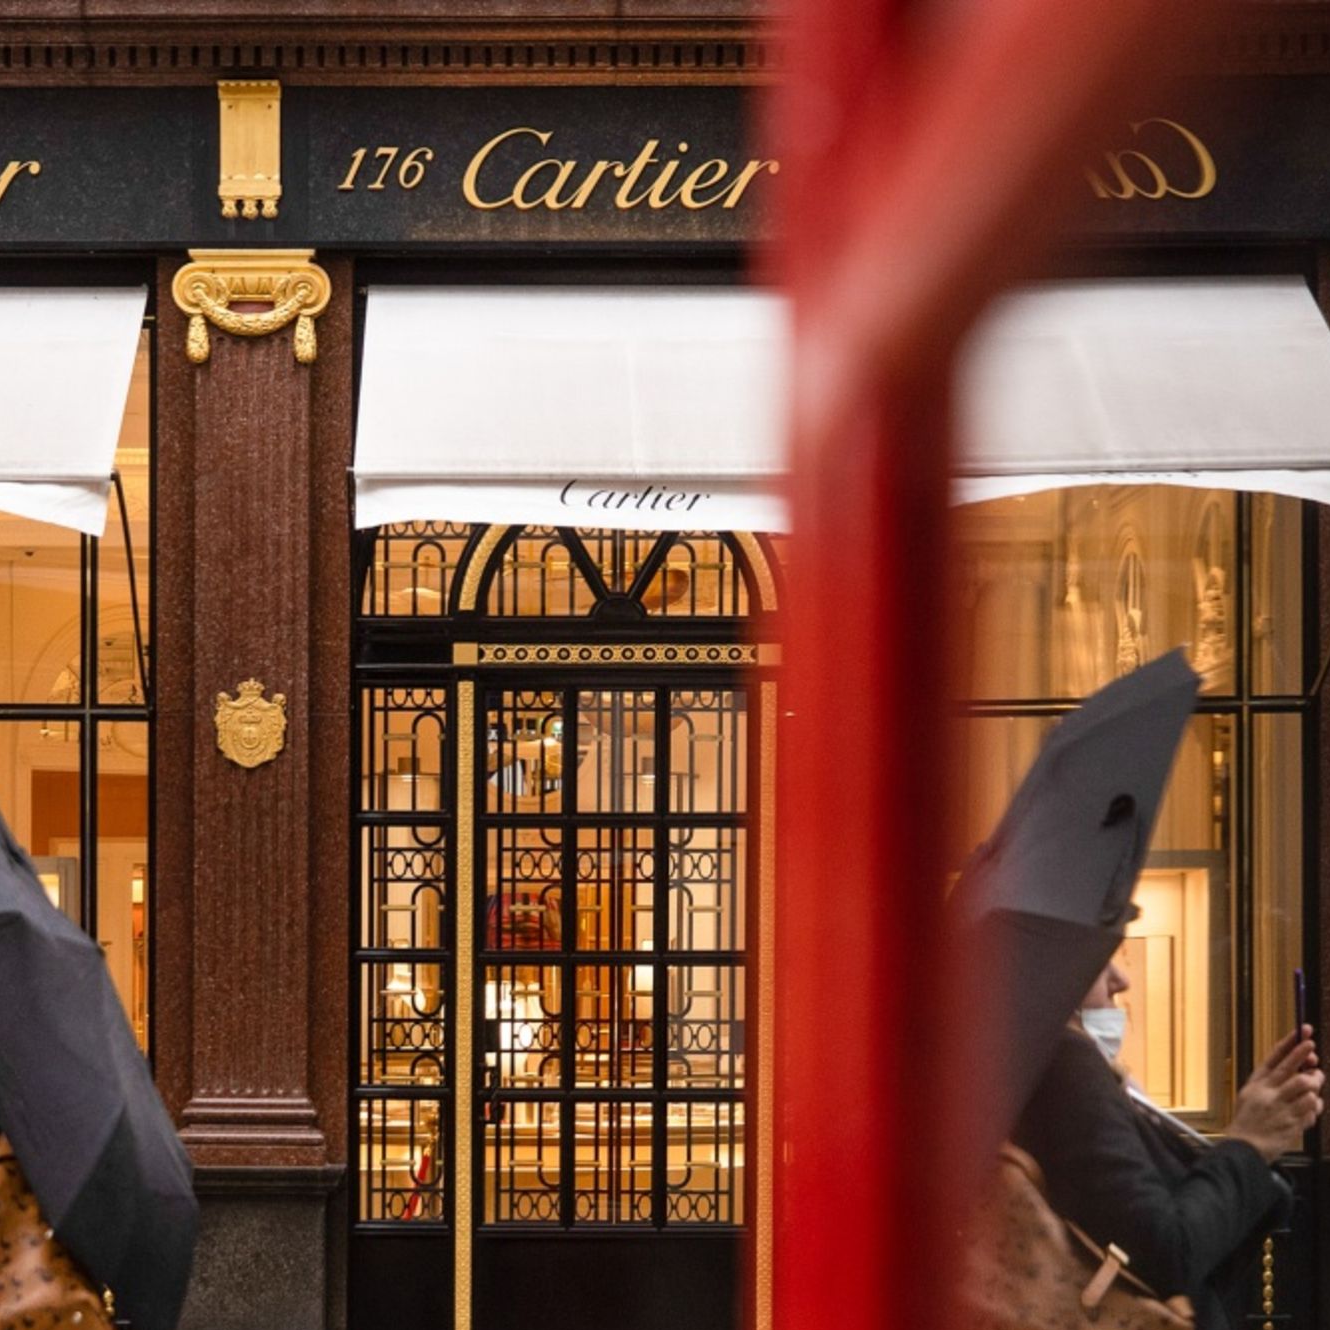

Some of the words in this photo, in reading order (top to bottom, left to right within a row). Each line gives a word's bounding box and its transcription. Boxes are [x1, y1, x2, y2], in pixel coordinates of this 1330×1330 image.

[337, 146, 433, 190] 176
[462, 127, 780, 210] Cartier
[559, 478, 711, 511] Cartier
